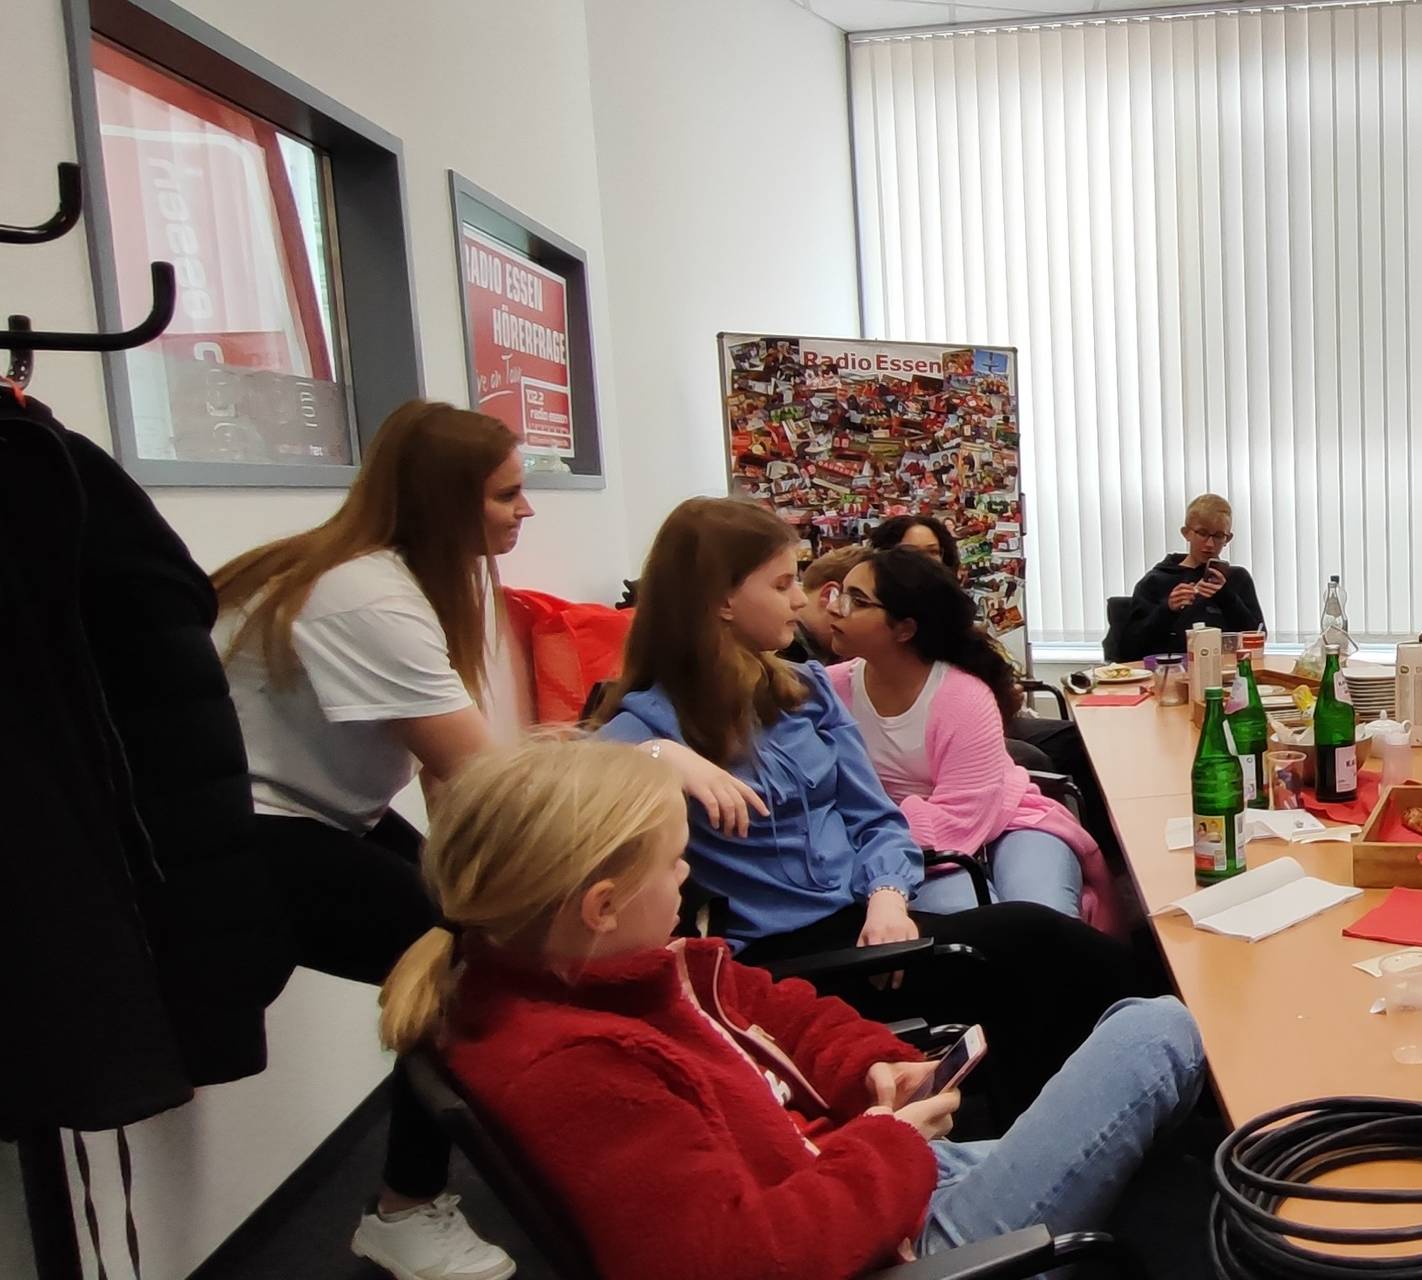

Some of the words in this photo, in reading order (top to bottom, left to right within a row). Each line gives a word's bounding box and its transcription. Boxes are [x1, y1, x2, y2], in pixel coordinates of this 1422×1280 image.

[506, 262, 543, 312] ESSEN
[493, 304, 567, 365] HÖRERFRAGE
[803, 351, 872, 370] Radio
[876, 354, 942, 373] Essen
